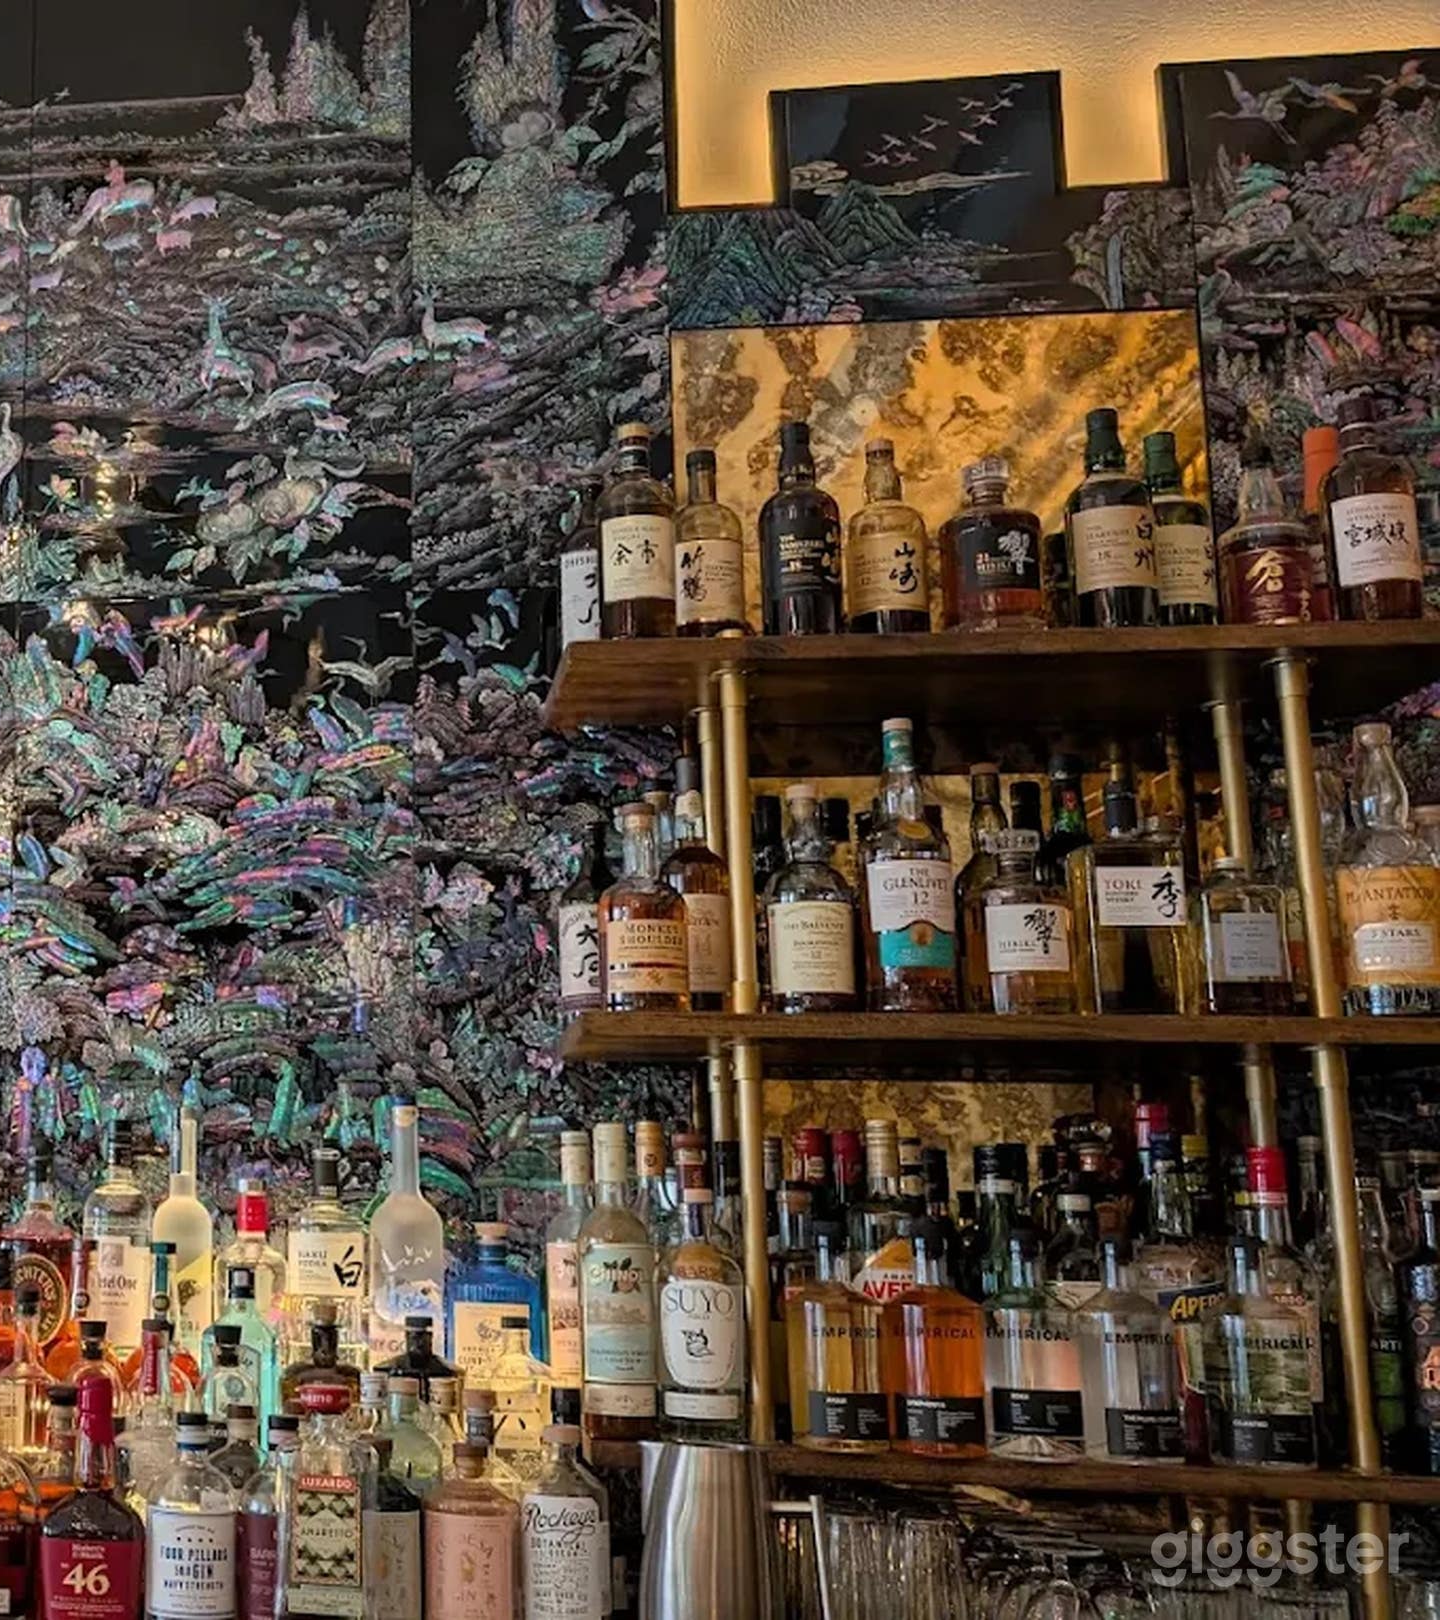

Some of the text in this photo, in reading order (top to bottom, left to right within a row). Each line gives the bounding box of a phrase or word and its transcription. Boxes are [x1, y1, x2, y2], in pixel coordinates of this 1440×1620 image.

[912, 891, 930, 906] 12
[333, 1244, 363, 1289] 白
[664, 1288, 734, 1314] SUYO
[985, 1327, 1071, 1342] EMPIRICAL
[301, 1476, 353, 1490] LUXARDO
[187, 1546, 229, 1563] PILLARS
[62, 1562, 111, 1596] 46
